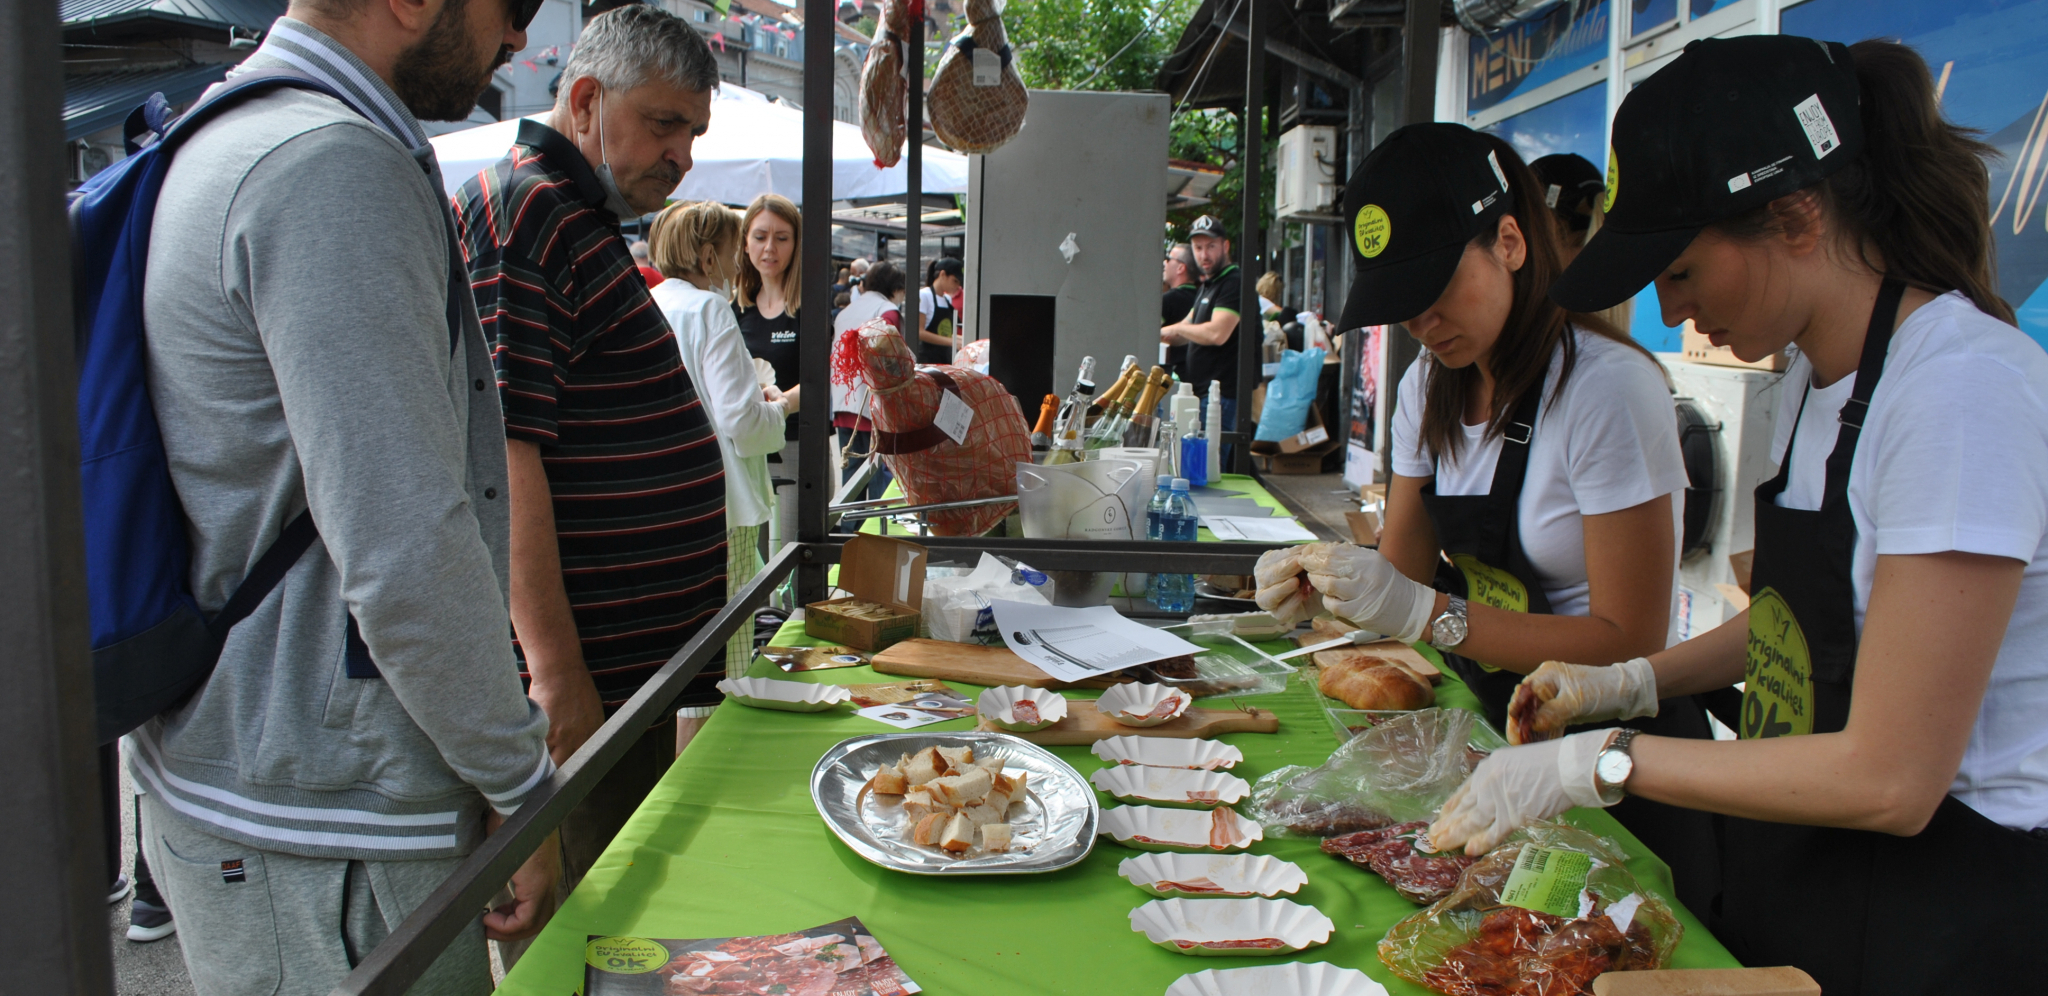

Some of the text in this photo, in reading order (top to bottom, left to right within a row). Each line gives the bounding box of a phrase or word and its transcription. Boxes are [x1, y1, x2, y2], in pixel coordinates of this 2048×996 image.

[1799, 102, 1822, 126] ENJOY
[1810, 124, 1833, 145] EUROPE
[1363, 234, 1381, 250] OK
[1756, 668, 1804, 717] kvalitet
[1745, 690, 1792, 739] OK
[607, 957, 649, 968] OK
[871, 978, 894, 989] ENJOY
